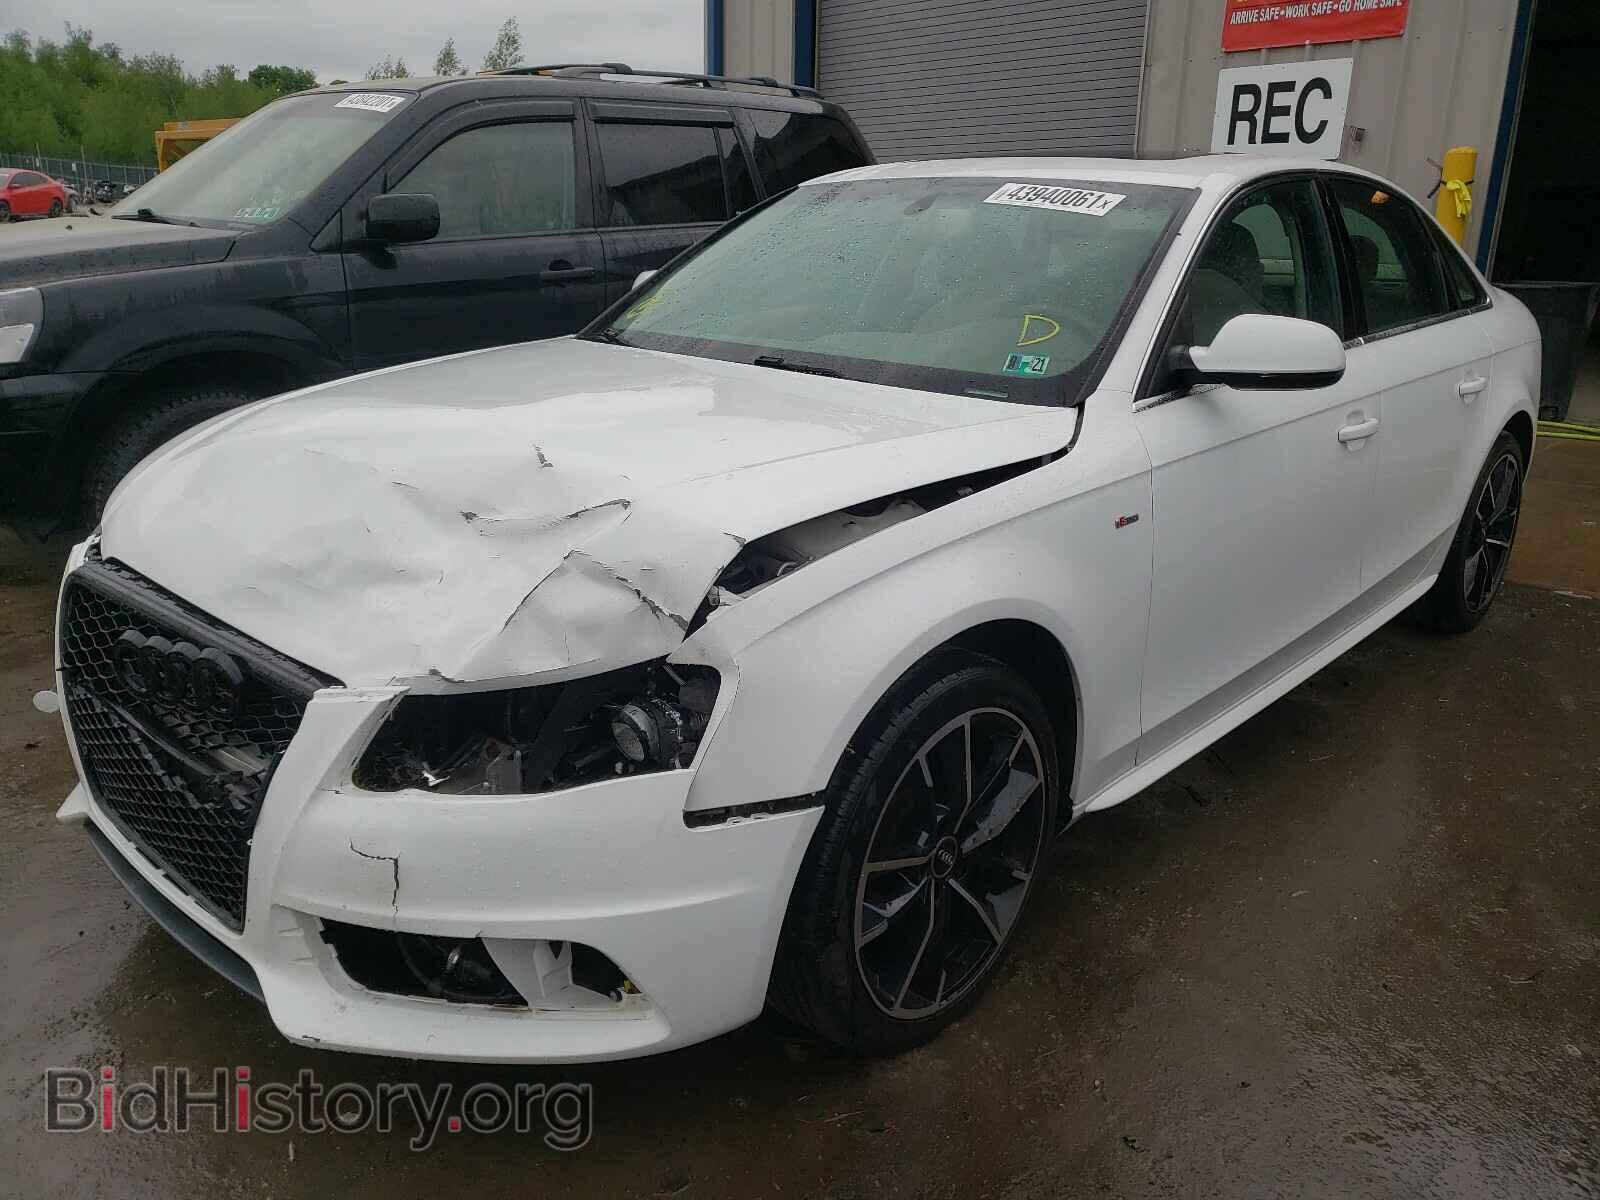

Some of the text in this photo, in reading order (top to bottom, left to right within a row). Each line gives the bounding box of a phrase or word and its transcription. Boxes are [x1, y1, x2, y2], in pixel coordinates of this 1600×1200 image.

[1230, 9, 1259, 24] ARRIVE
[1227, 77, 1332, 145] REC
[1017, 314, 1061, 347] D
[1032, 357, 1046, 372] 21
